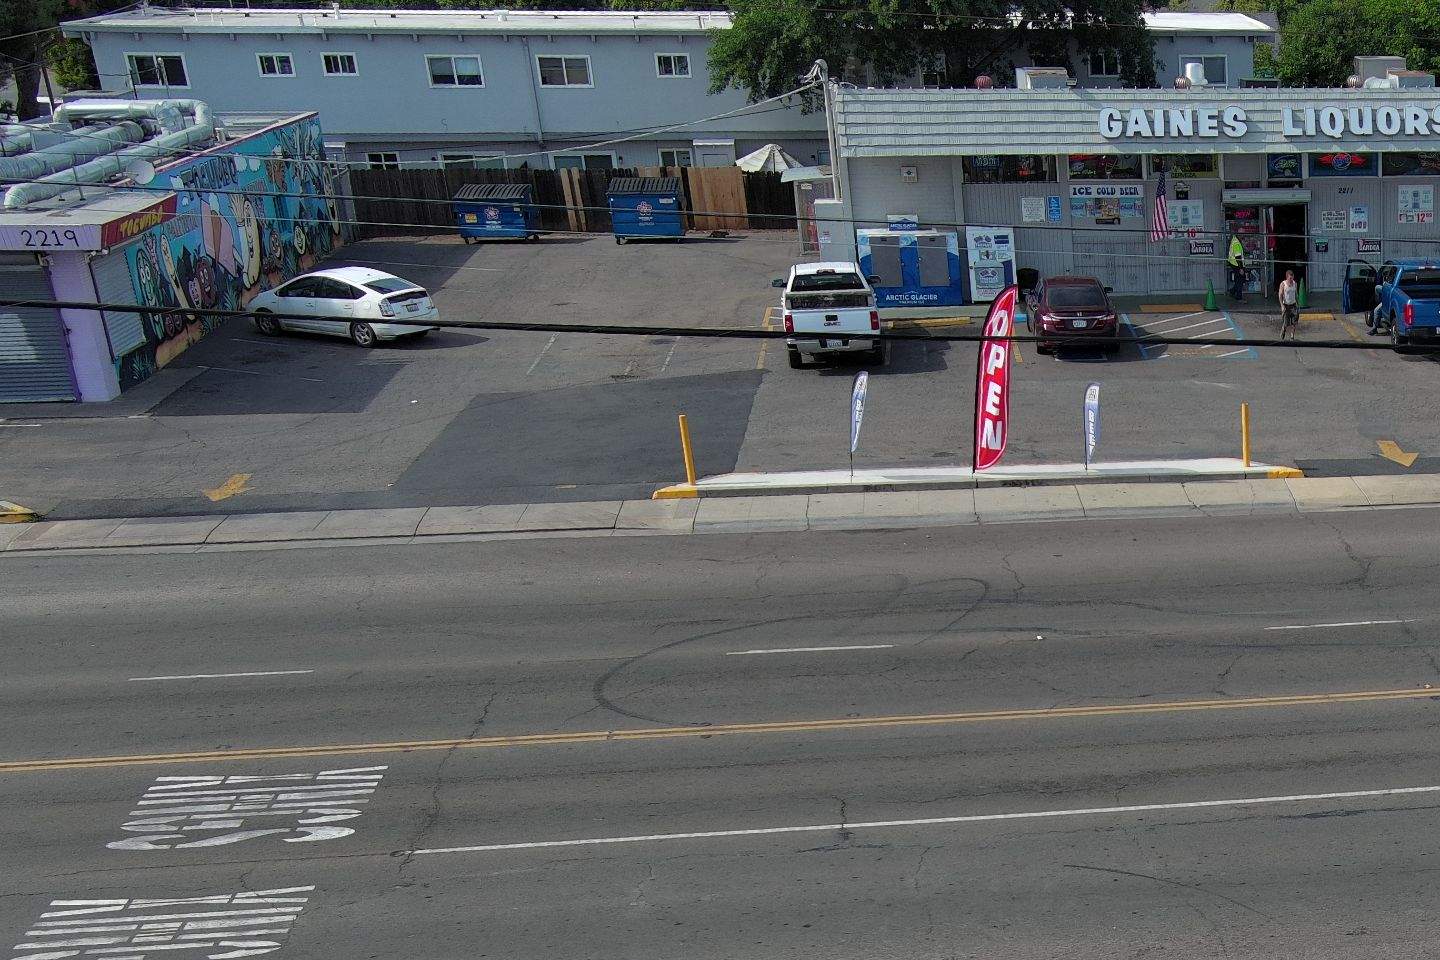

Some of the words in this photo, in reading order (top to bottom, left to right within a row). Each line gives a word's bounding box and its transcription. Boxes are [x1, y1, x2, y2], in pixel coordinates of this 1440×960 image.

[1099, 105, 1250, 139] GAINES
[1072, 186, 1093, 196] ICE
[1096, 186, 1116, 196] COLD
[1119, 186, 1140, 196] BEER
[120, 205, 164, 237] TOCUMBO
[20, 229, 80, 248] 2219
[981, 309, 1009, 450] OPEN
